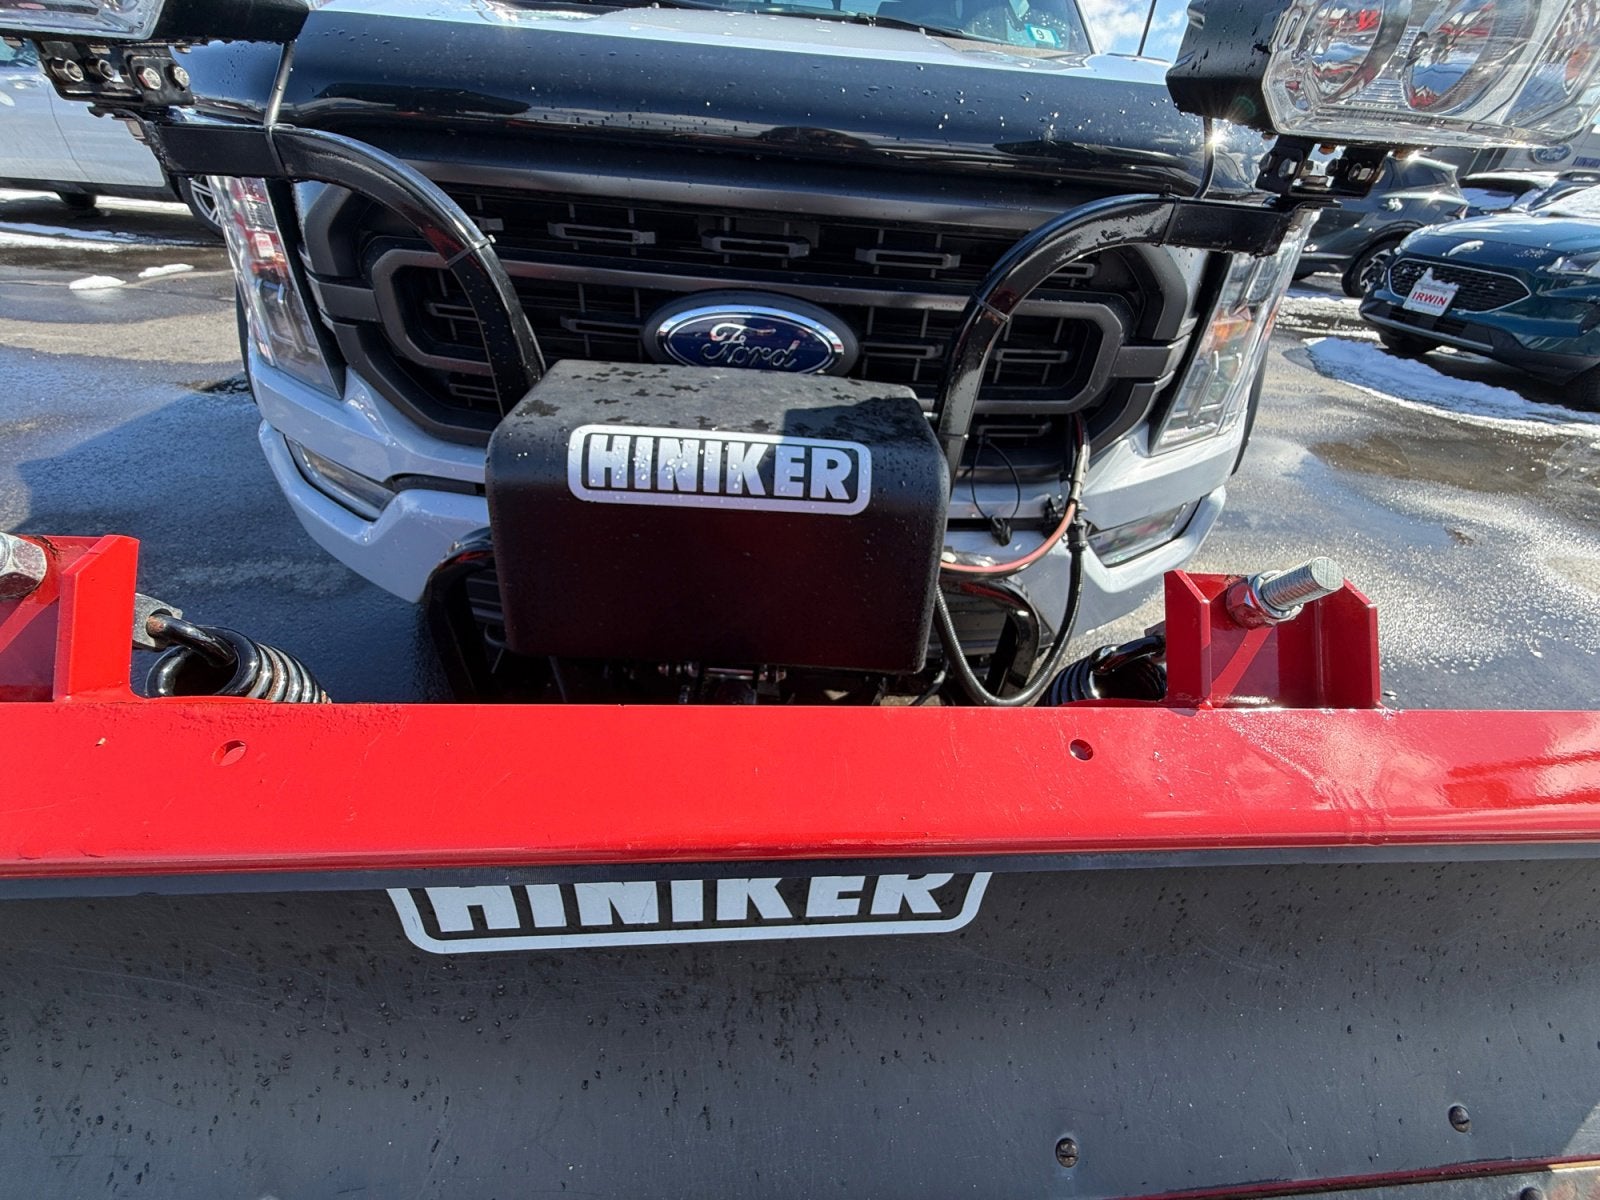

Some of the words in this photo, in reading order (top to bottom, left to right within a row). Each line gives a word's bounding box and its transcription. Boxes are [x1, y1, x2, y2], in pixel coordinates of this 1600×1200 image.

[1412, 291, 1448, 306] IRWIN
[701, 322, 800, 369] Ford
[588, 434, 852, 500] HINIKER
[424, 872, 954, 933] HINIKER
